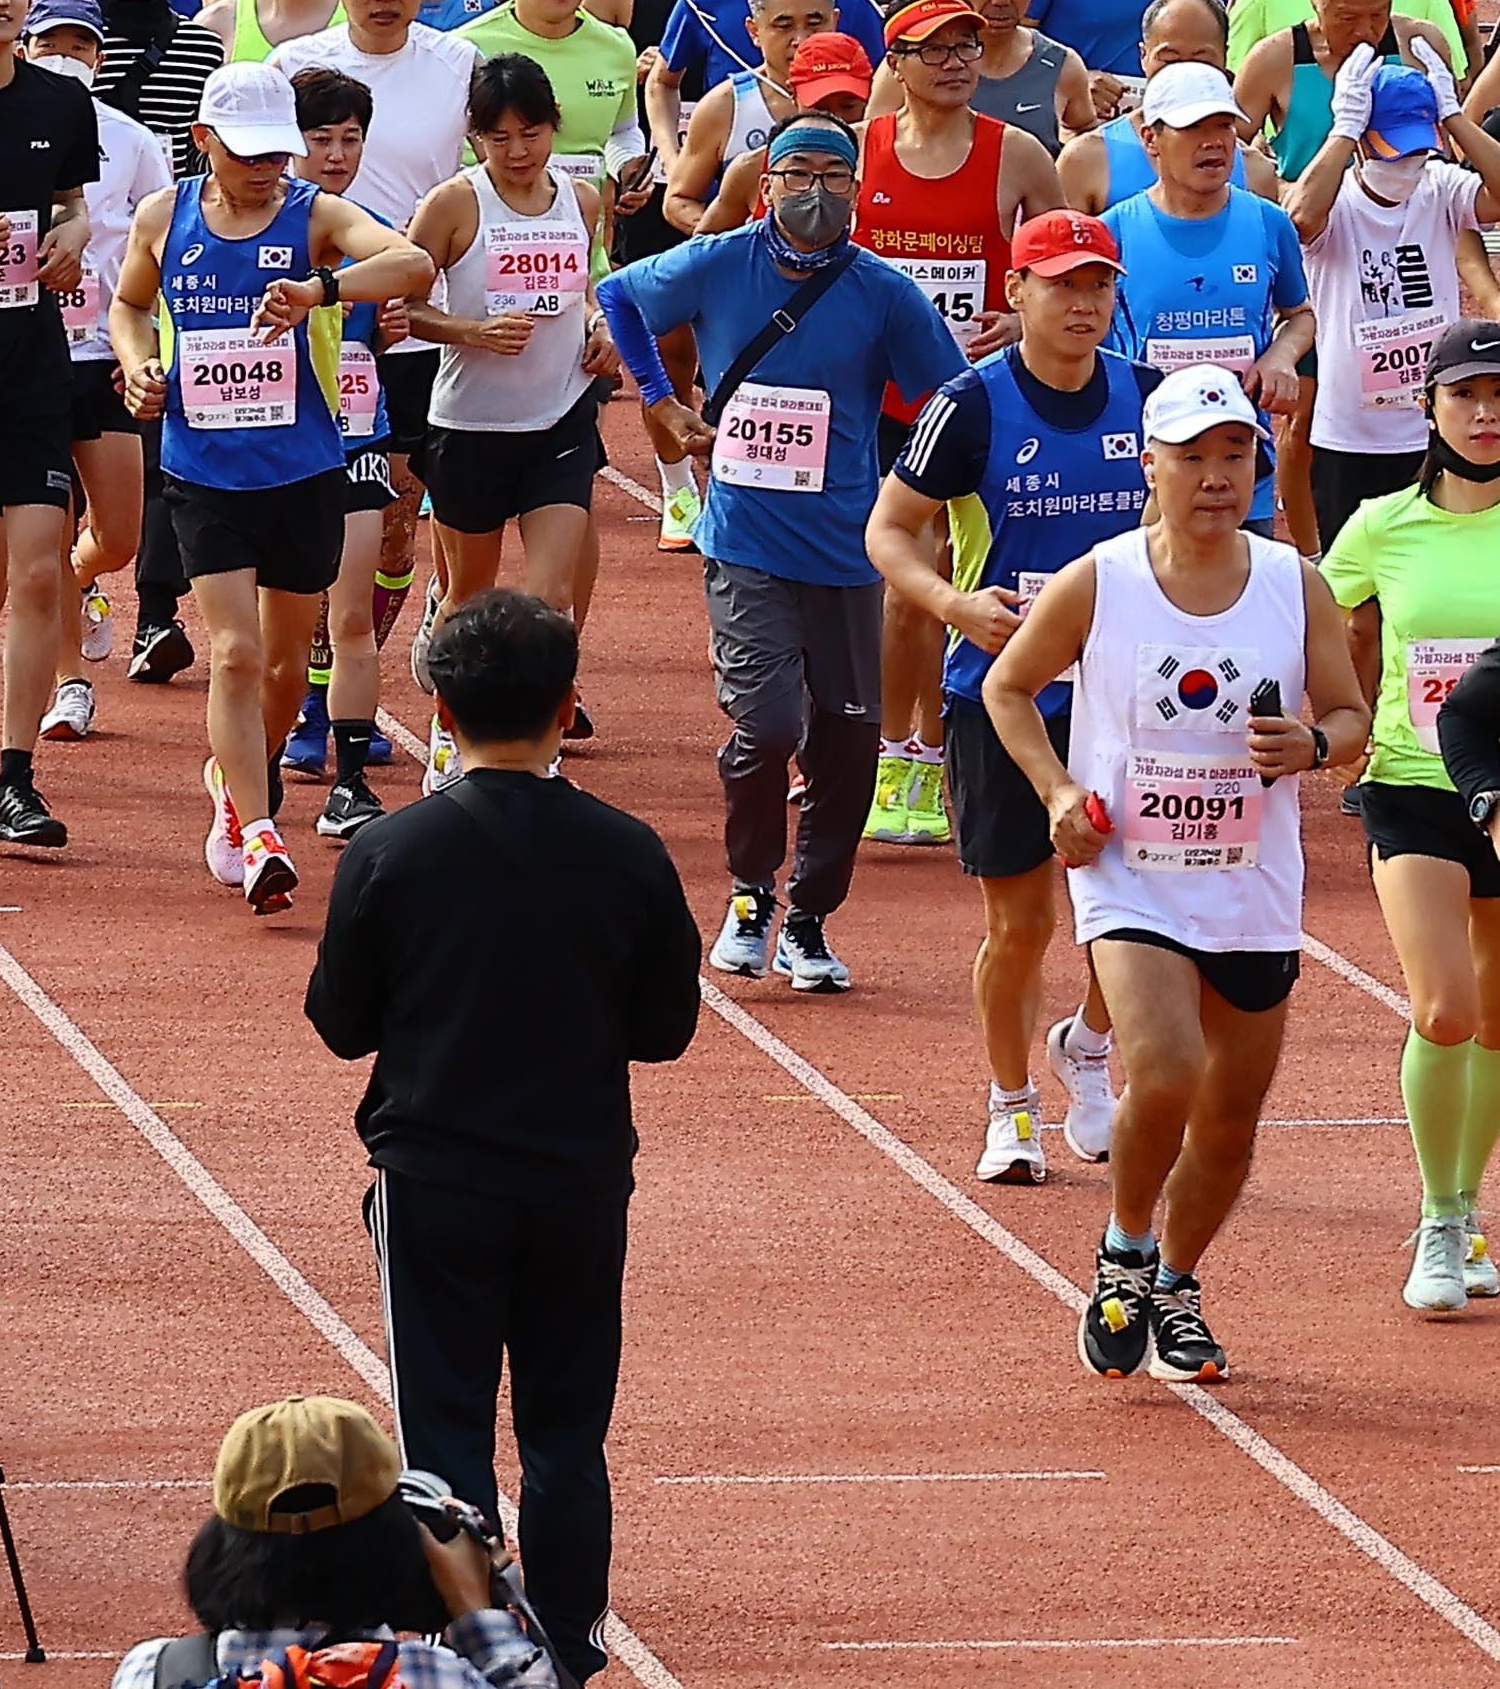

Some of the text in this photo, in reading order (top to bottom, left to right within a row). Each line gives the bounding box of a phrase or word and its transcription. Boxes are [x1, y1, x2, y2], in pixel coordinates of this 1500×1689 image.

[30, 140, 51, 150] FILA
[870, 228, 984, 255] 광화문페이싱팀
[498, 252, 579, 275] 28014
[899, 263, 980, 282] 이스메이커
[1155, 307, 1246, 332] 청평마라톤
[193, 360, 283, 386] 20048
[726, 416, 814, 447] 20155
[746, 443, 787, 462] 정대성
[1007, 489, 1145, 517] 조치원마라톤클럽
[1134, 763, 1258, 780] 가평자라섬 전국 마라톤대회
[1214, 780, 1241, 796] 220
[1139, 787, 1244, 821] 20091
[1171, 822, 1219, 841] 김기홍
